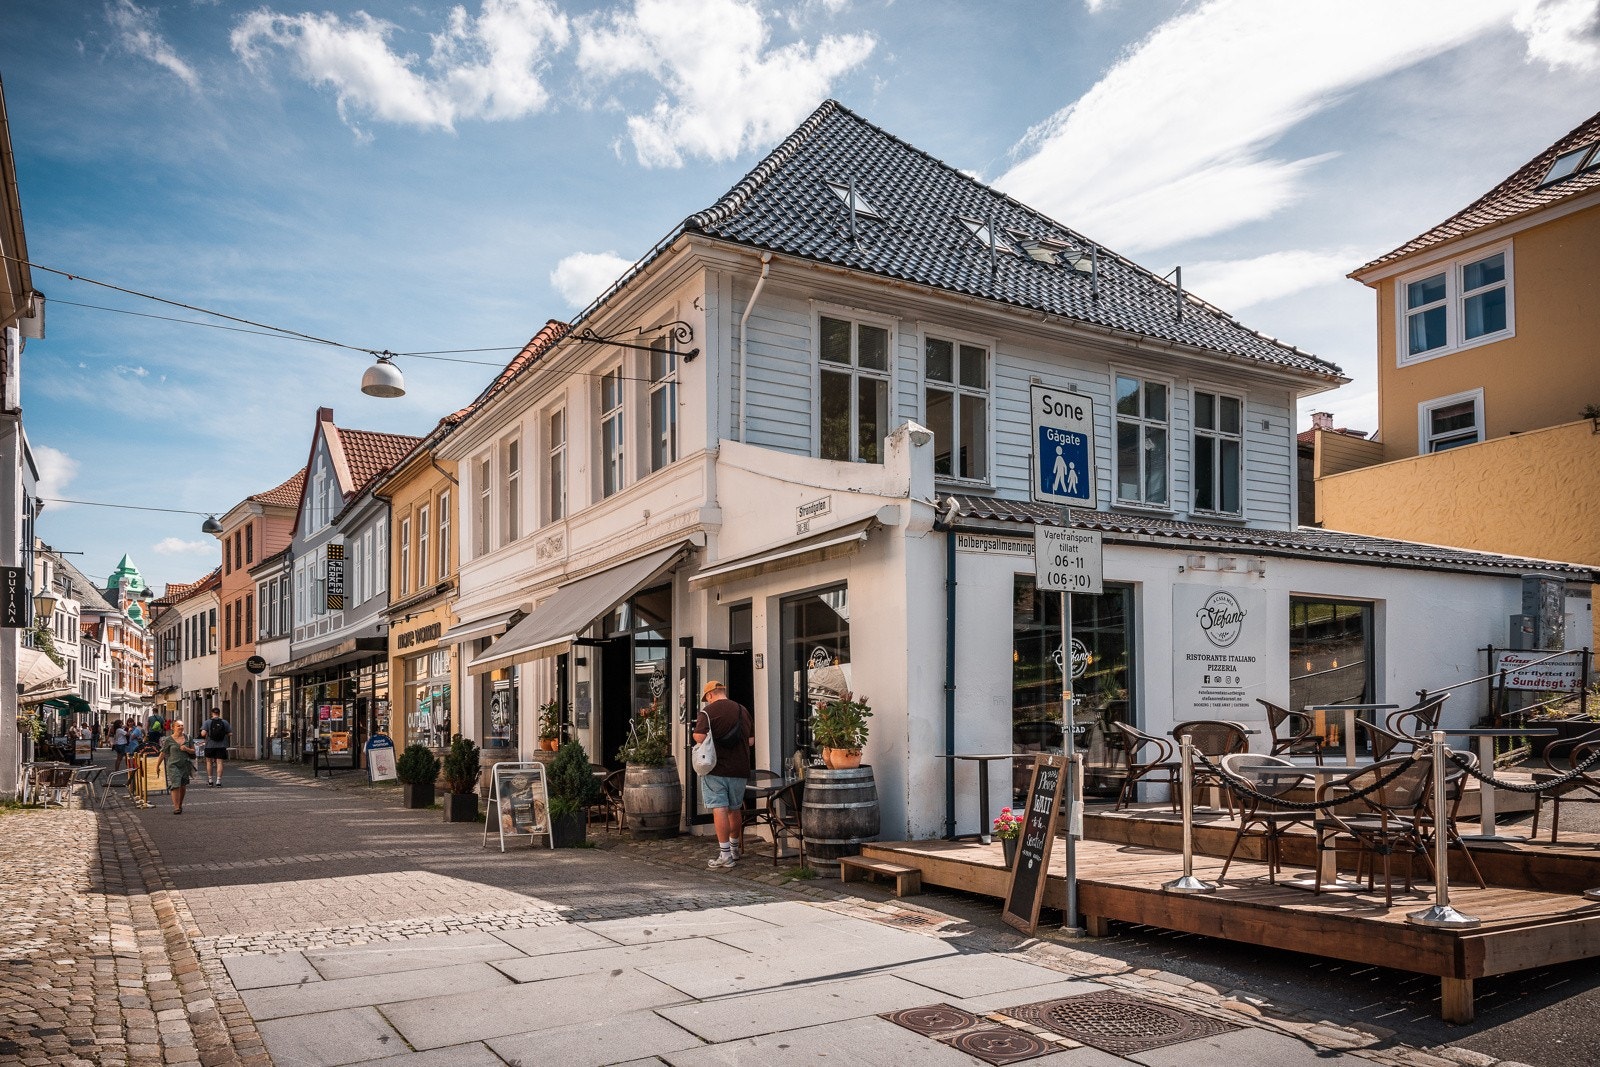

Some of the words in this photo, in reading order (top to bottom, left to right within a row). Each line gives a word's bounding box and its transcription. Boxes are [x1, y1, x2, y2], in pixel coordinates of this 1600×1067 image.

[1042, 394, 1083, 421] Sone
[1047, 428, 1081, 446] Gågate
[799, 501, 826, 517] Strandgaten
[958, 535, 1035, 555] Holbergsallmenninge
[1044, 530, 1093, 543] Varetransport
[1059, 543, 1078, 553] tillatt
[8, 570, 16, 623] DUXIANA
[1196, 607, 1247, 630] Stefano
[398, 630, 414, 650] more
[415, 622, 441, 644] woman
[1186, 654, 1227, 662] RISTORANTE
[1512, 677, 1566, 689] Sundtsgt.
[1570, 679, 1582, 688] 38
[1033, 794, 1053, 814] WAIT
